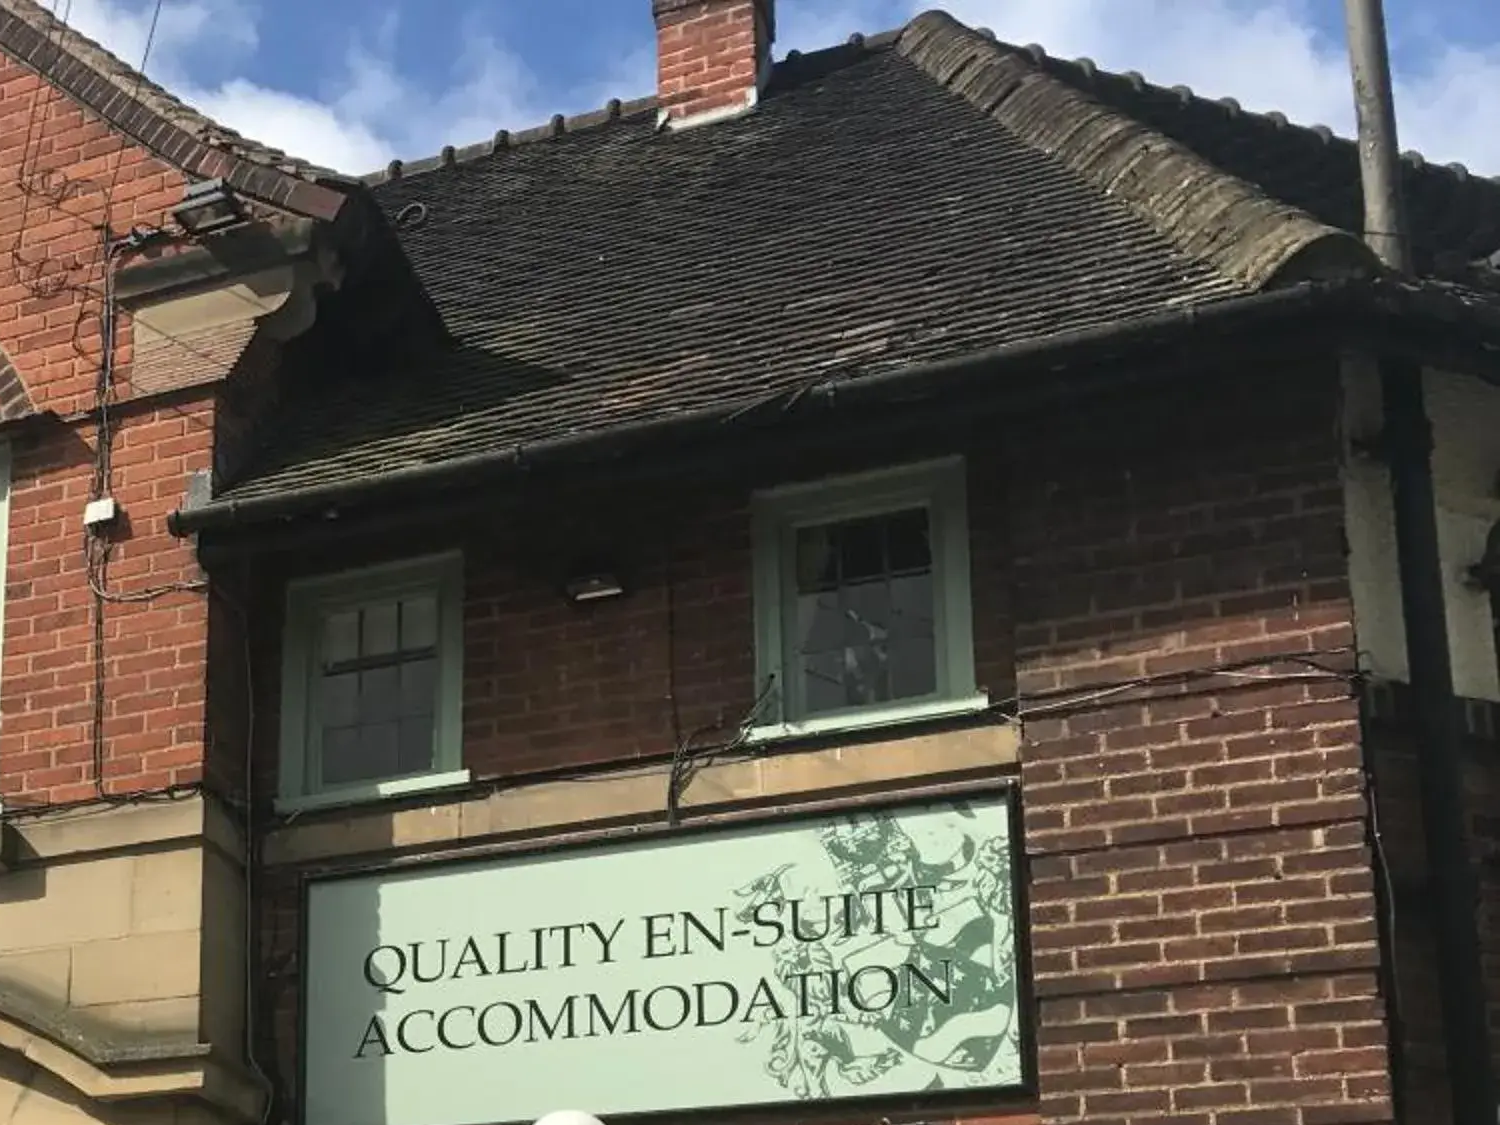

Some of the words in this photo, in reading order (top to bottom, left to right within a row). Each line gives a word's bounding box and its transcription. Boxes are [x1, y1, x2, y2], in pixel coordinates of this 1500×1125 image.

[362, 918, 625, 993] QUALITY
[642, 886, 940, 959] EN-SUITE
[353, 960, 953, 1059] ACCOMMODATION
